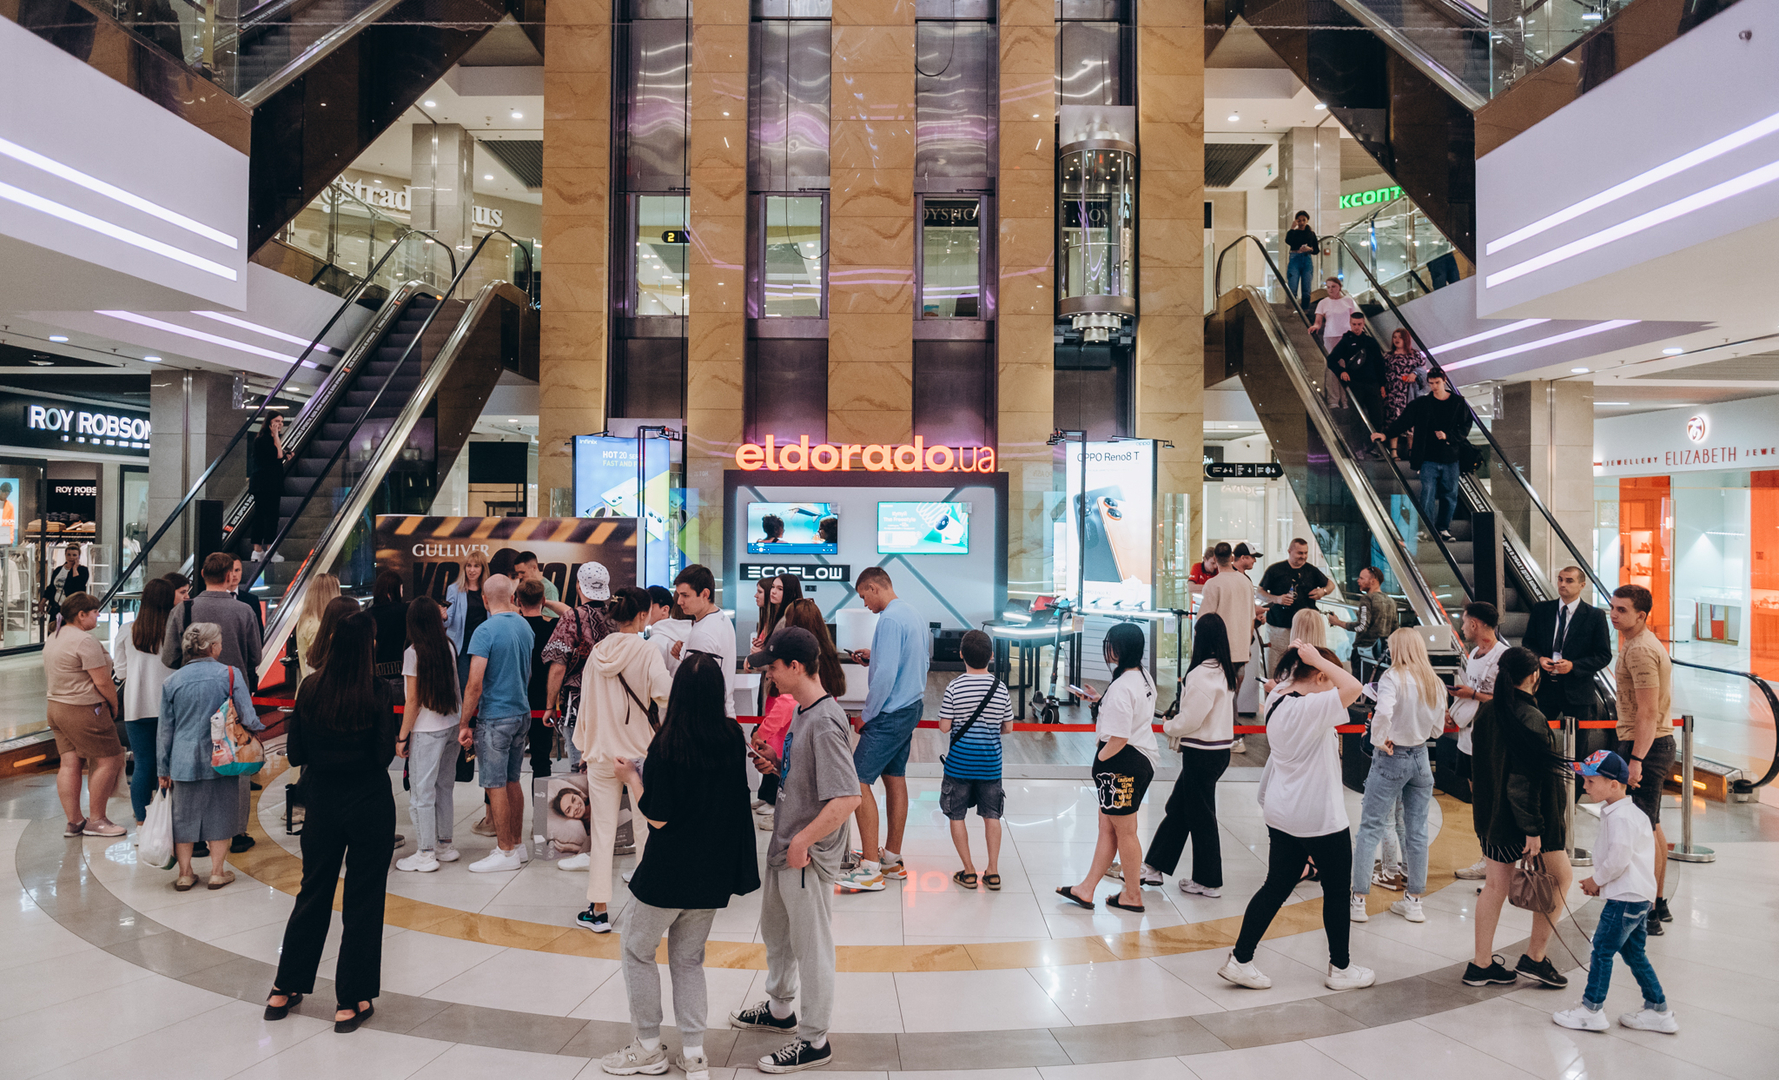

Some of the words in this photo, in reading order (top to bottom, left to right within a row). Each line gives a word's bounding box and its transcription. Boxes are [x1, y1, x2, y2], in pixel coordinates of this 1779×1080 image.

[667, 232, 675, 242] 2
[29, 404, 74, 432] ROY
[602, 450, 618, 459] HOT
[619, 451, 628, 459] 20
[735, 434, 996, 473] eldorado.ua
[1104, 451, 1132, 462] Reno8
[1133, 451, 1140, 461] T
[1606, 456, 1658, 467] JEWELLERY
[1665, 446, 1737, 466] ELIZABETH
[55, 486, 72, 494] ROY
